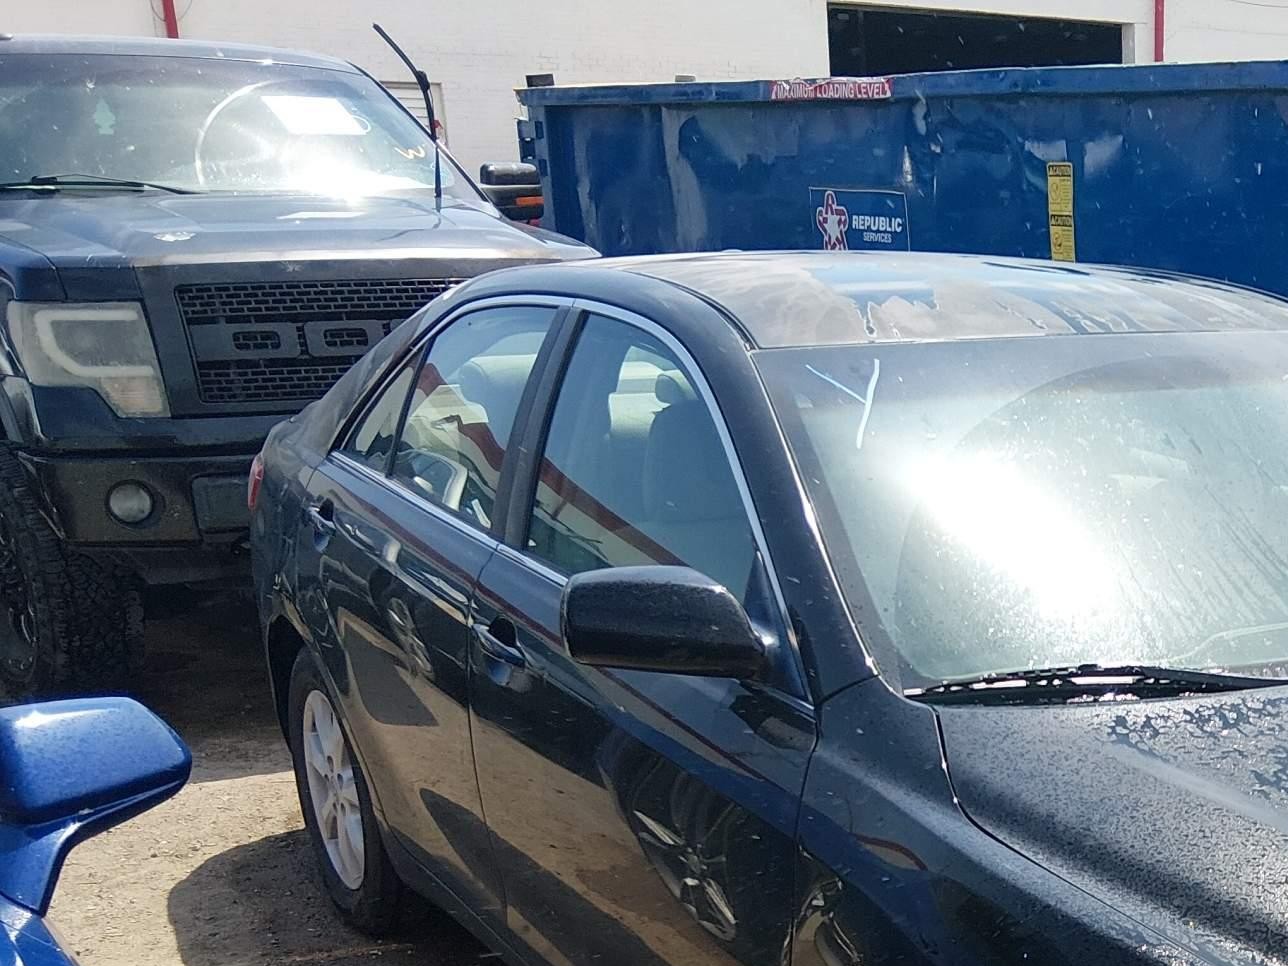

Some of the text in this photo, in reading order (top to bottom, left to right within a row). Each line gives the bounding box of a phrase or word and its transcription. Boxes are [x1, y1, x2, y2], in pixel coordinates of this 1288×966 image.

[816, 82, 854, 98] LOADING
[856, 82, 884, 98] LEVEL
[852, 214, 903, 233] REPUBLIC
[863, 231, 892, 243] SERVICES
